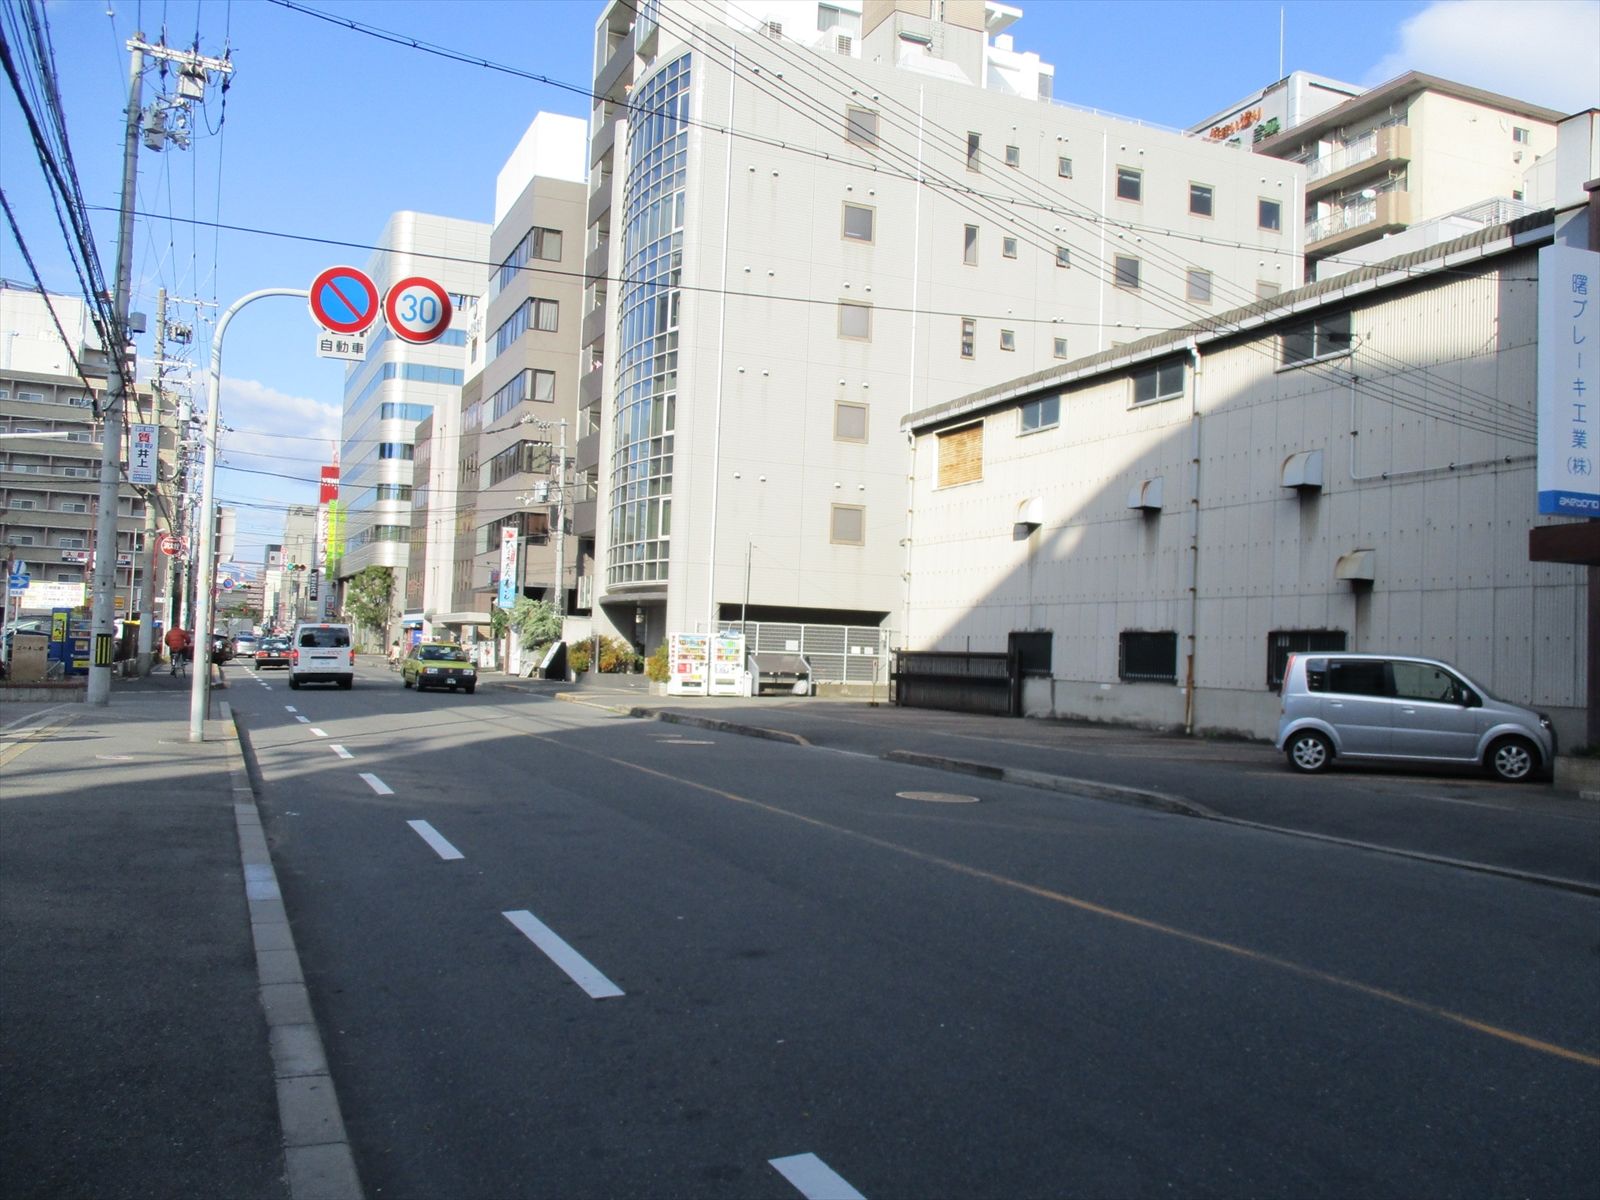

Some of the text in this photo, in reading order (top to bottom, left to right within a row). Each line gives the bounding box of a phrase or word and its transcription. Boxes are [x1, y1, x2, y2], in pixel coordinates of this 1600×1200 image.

[401, 294, 437, 324] 30
[320, 339, 364, 354] 自動車
[1567, 274, 1592, 476] 曙ブレーキ工業（株）
[137, 449, 150, 468] 井上
